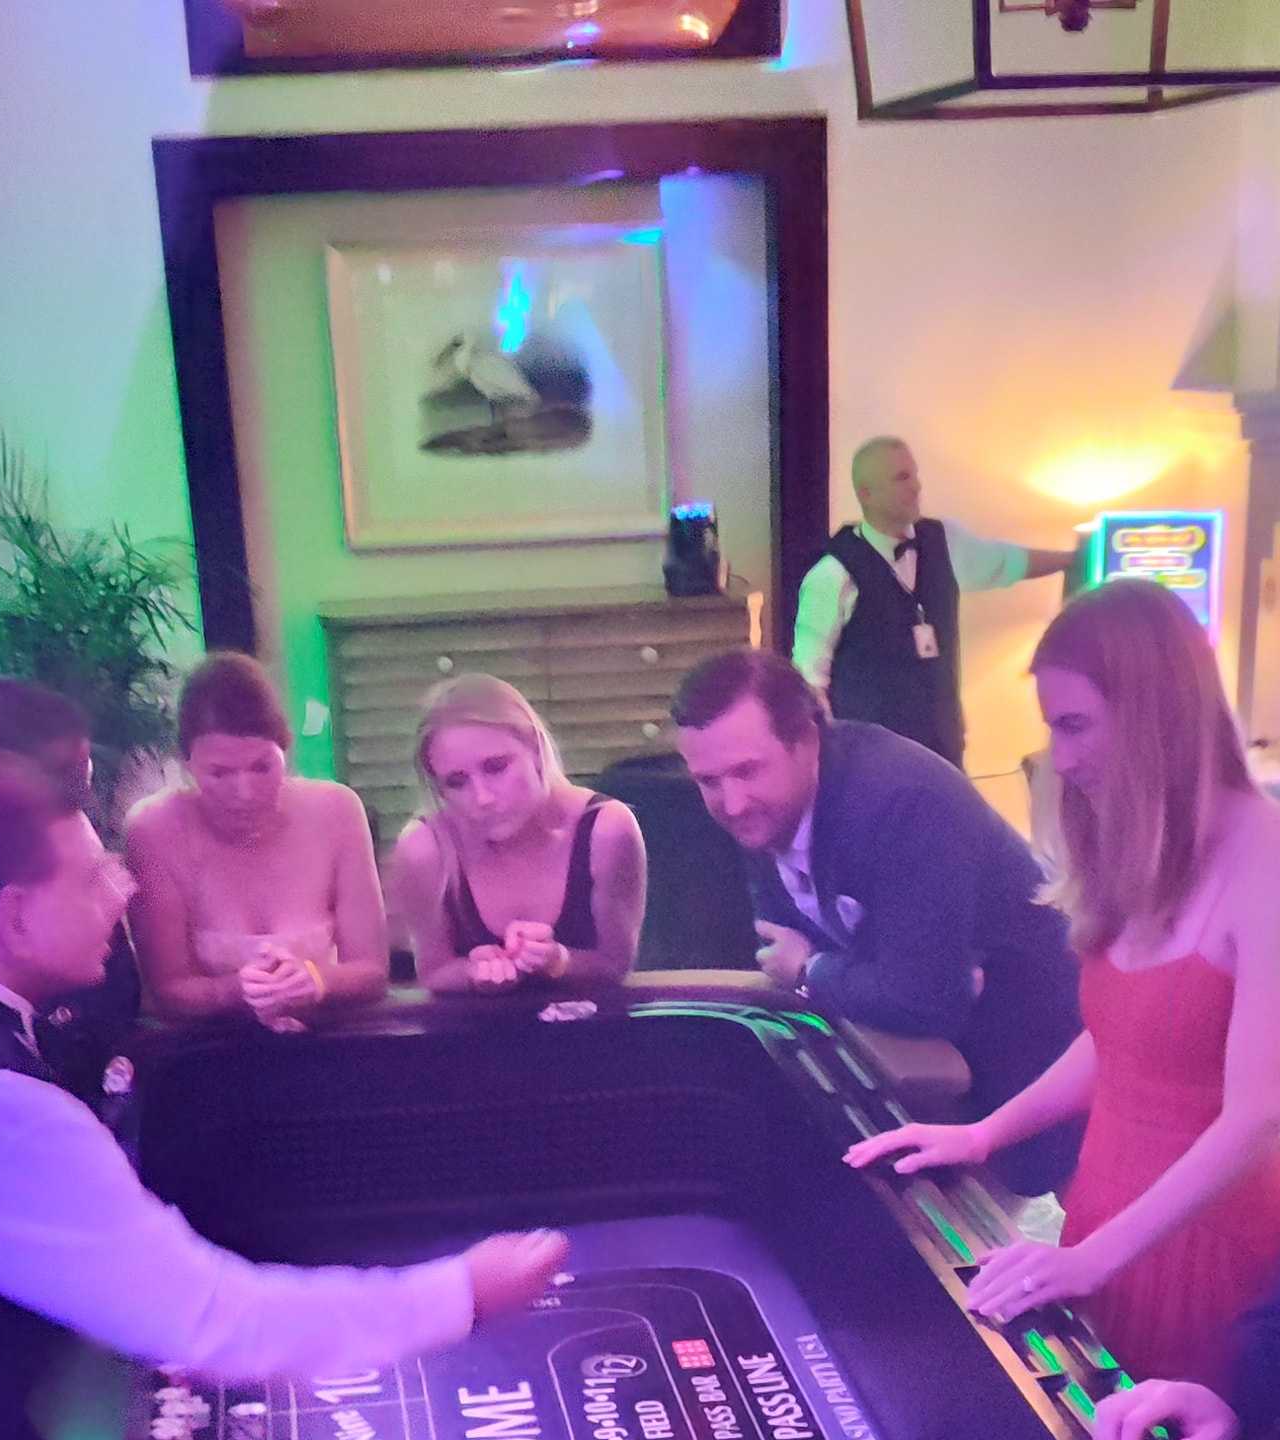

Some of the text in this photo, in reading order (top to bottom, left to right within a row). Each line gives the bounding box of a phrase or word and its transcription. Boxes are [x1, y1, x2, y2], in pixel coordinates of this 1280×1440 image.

[736, 1351, 814, 1440] PASS LINE
[635, 1400, 674, 1440] FIELD
[702, 1404, 743, 1440] PASS
